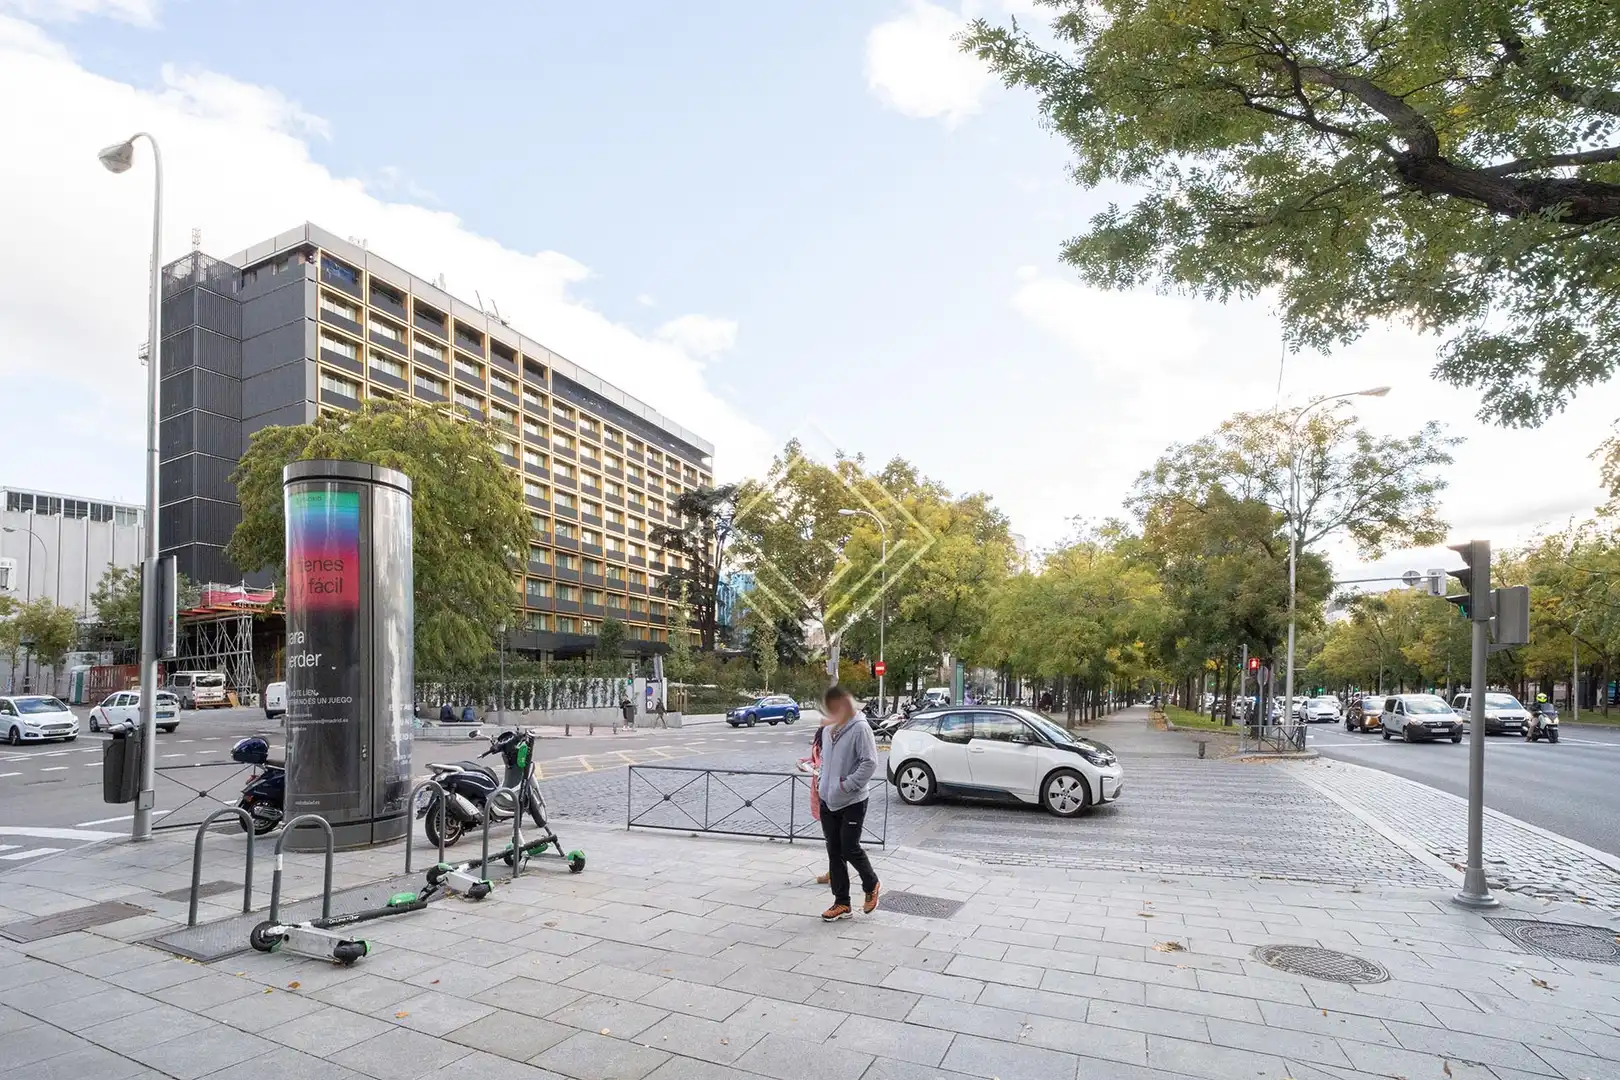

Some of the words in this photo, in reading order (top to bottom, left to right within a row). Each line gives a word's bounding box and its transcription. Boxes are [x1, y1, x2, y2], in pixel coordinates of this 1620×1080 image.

[308, 577, 343, 594] fácil
[287, 631, 305, 645] ara
[287, 650, 322, 668] erder
[317, 697, 327, 705] UN
[328, 696, 353, 704] JUEGO
